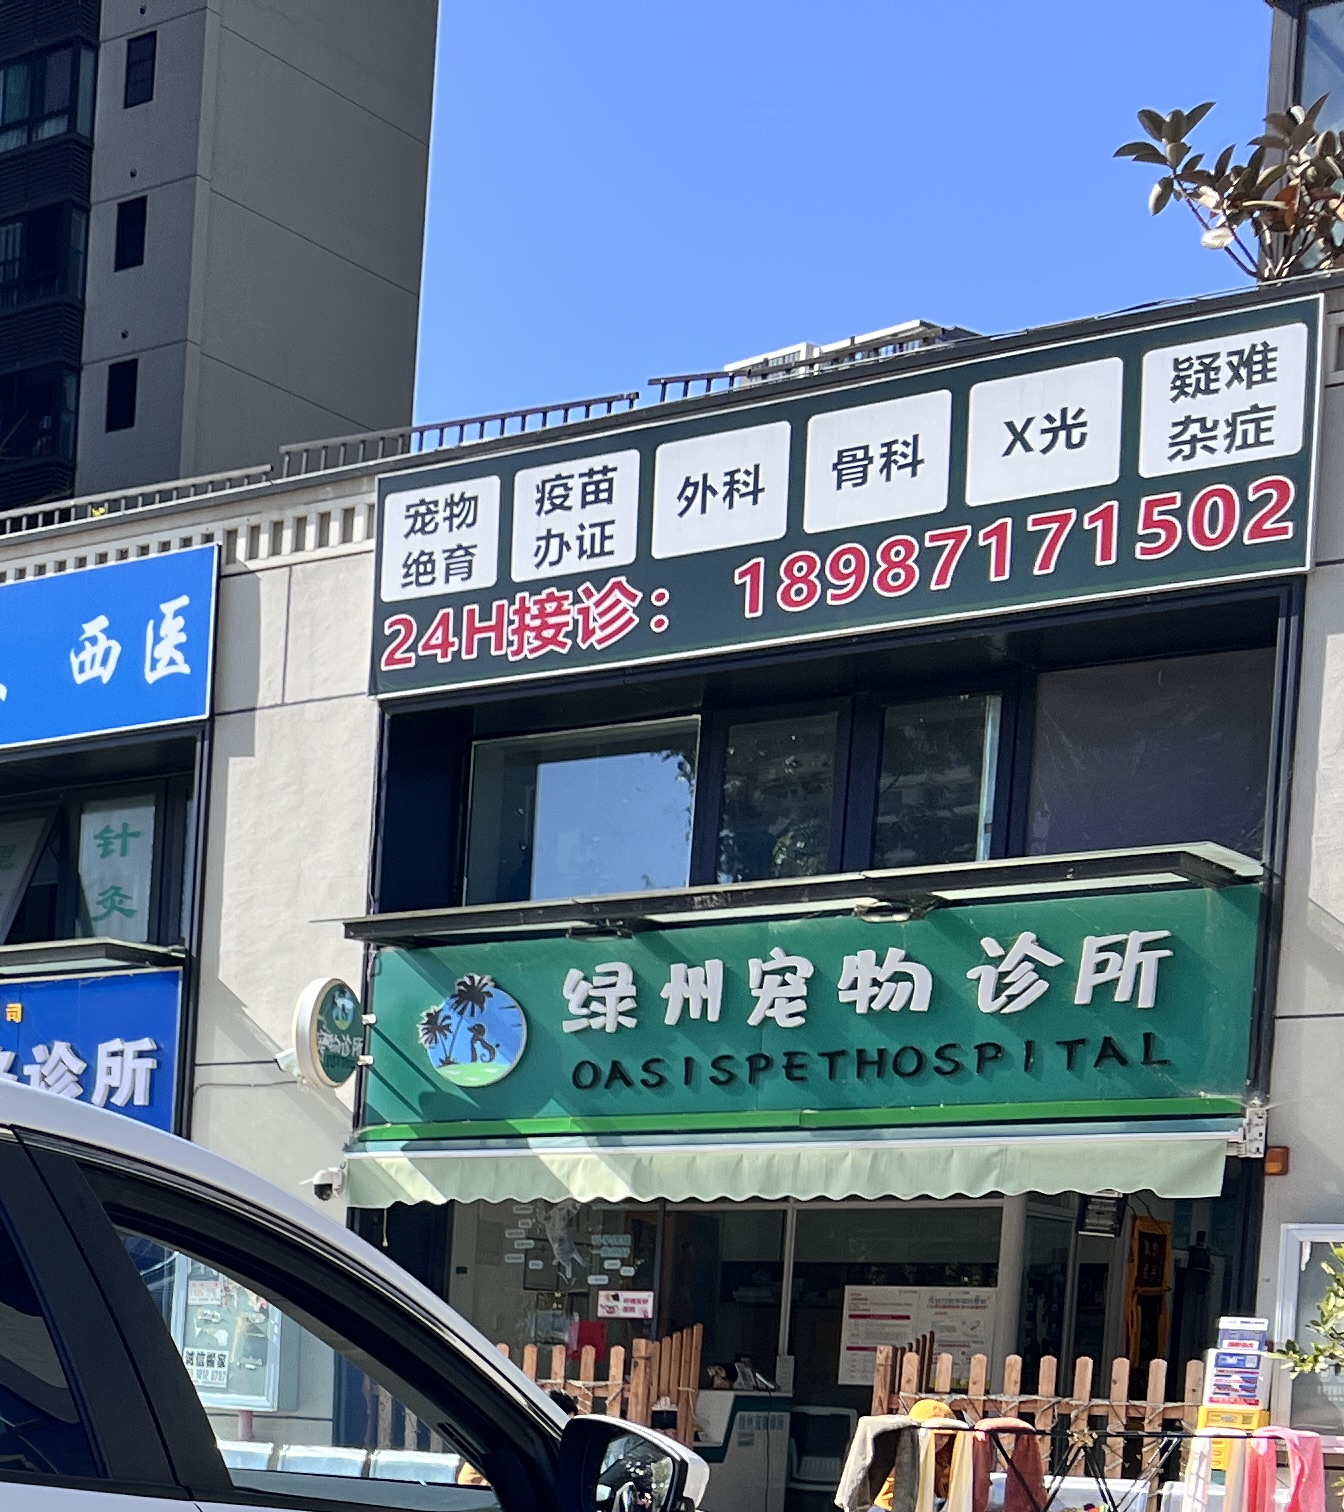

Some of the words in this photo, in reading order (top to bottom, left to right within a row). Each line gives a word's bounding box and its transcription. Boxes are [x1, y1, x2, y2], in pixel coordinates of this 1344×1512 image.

[1169, 340, 1278, 402] 疑难
[1001, 406, 1089, 457] X光
[1167, 402, 1277, 463] 杂症
[534, 464, 617, 516] 疫苗
[831, 433, 925, 491] 骨科
[403, 491, 479, 541] 宠物
[676, 463, 766, 518] 外科
[401, 542, 479, 590] 绝育
[533, 520, 616, 573] 办证
[736, 476, 1295, 617] 18987171502
[91, 821, 143, 923] 针灸
[561, 929, 1174, 1033] 绿州宠物诊所
